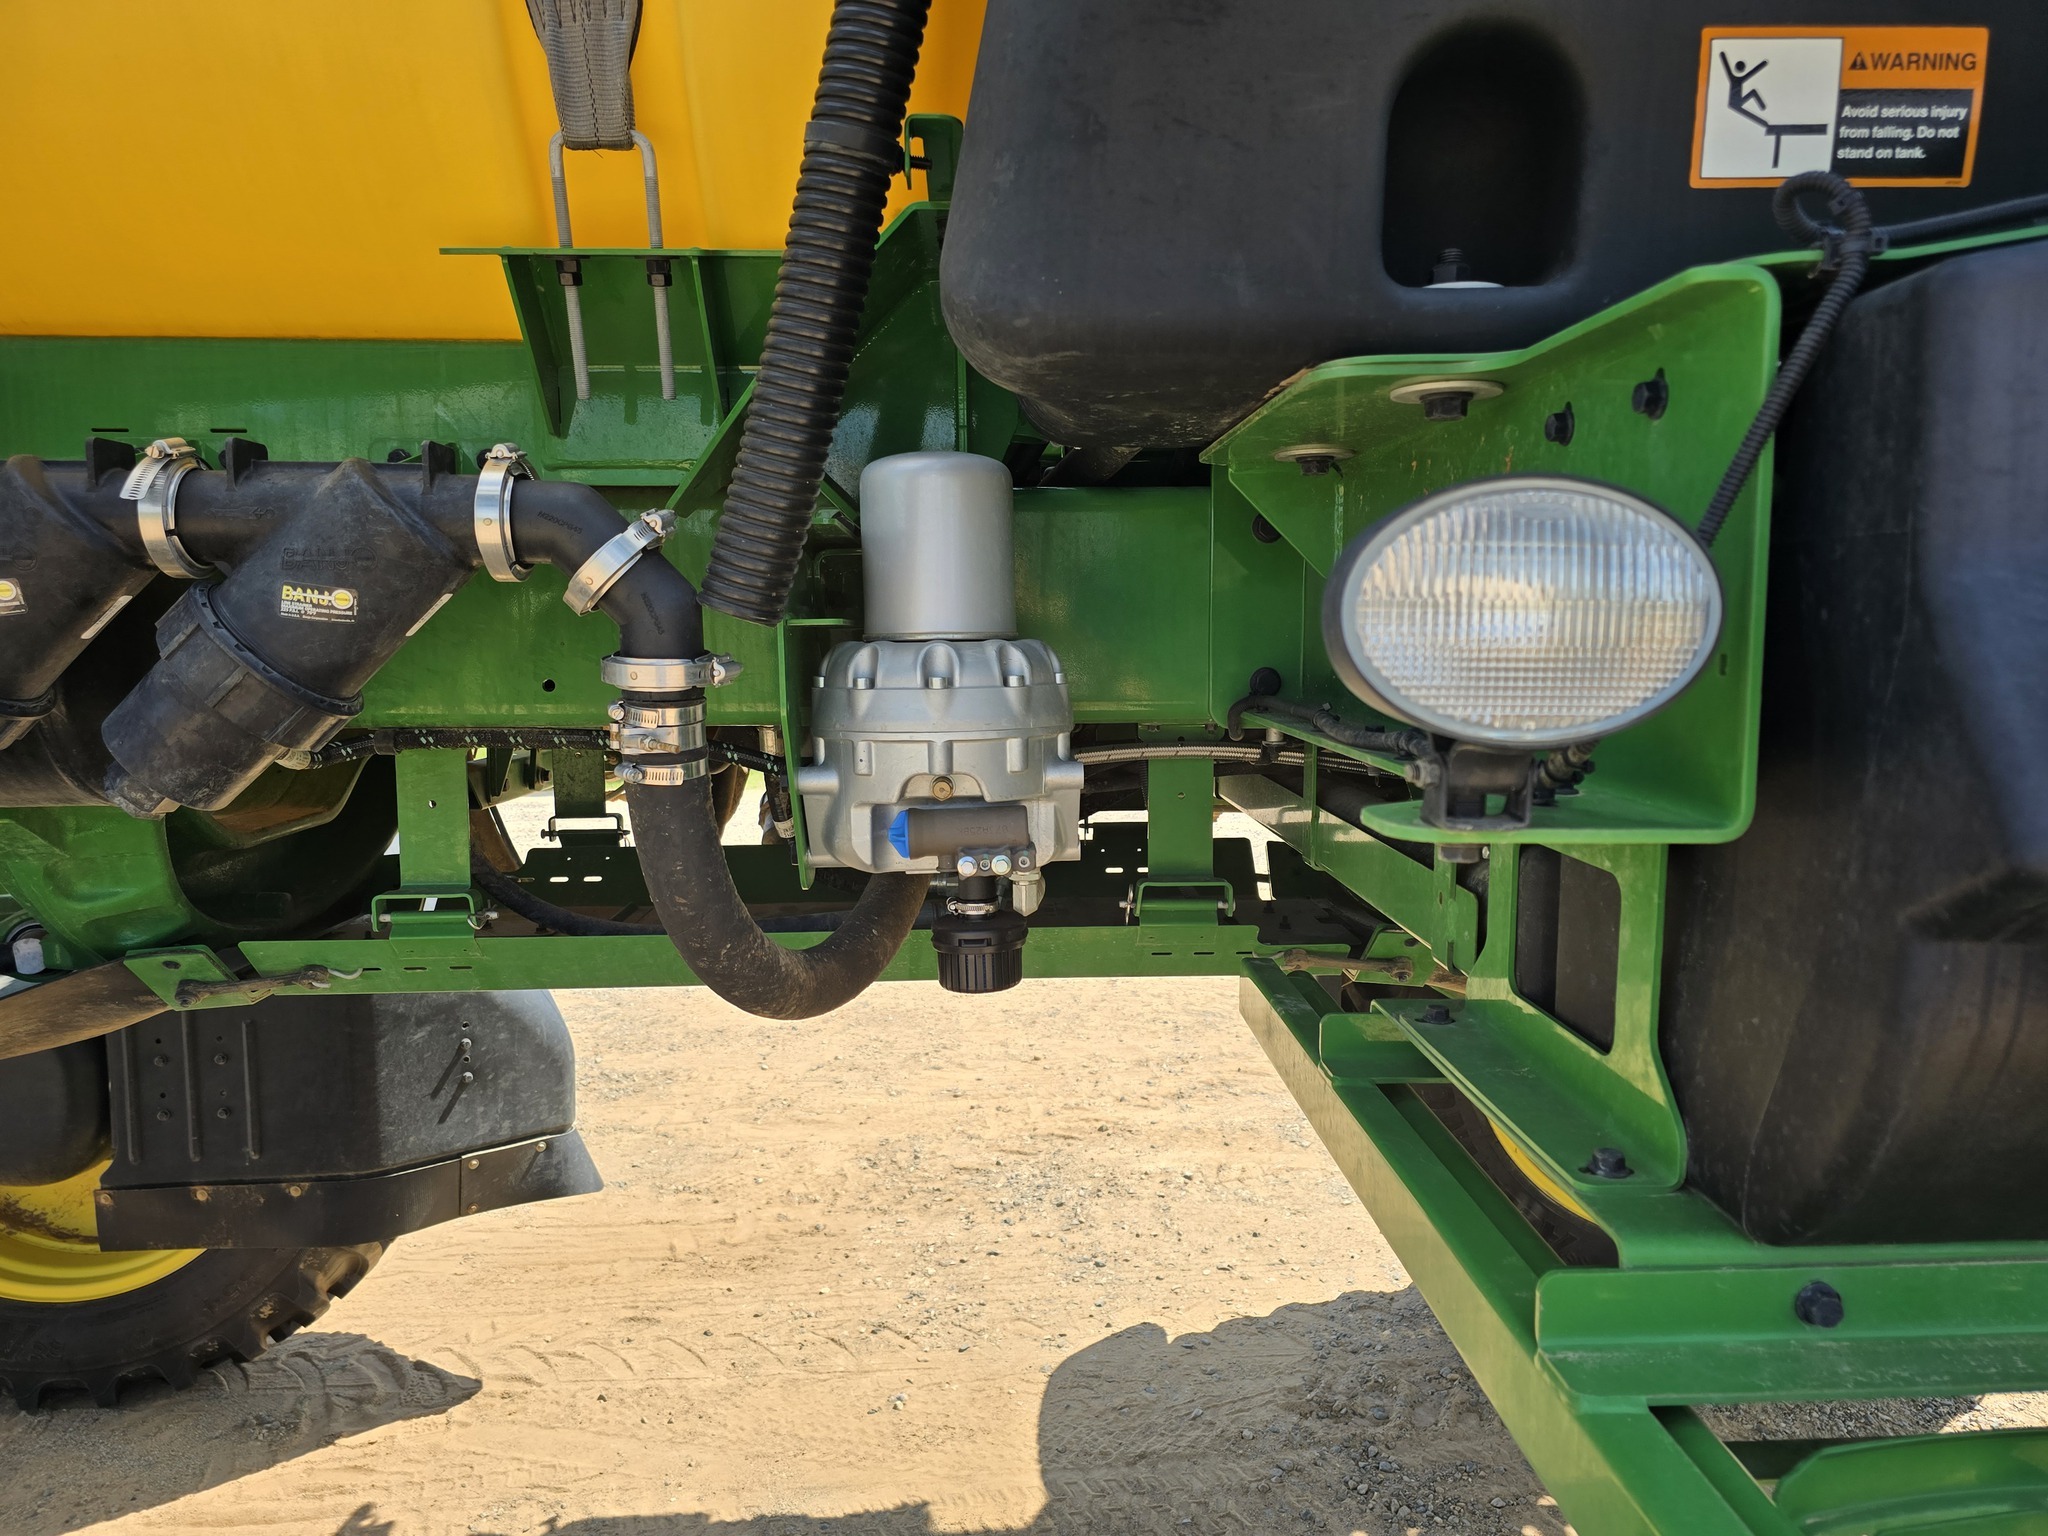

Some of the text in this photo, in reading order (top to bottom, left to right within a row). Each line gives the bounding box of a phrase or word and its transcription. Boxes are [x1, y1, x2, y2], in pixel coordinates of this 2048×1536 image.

[1870, 52, 1977, 71] WARNING
[1841, 105, 1968, 120] Avoid serious injury
[1839, 125, 1960, 141] from falling. Do not
[1836, 146, 1926, 159] stand on tank.
[281, 585, 354, 610] BANJO
